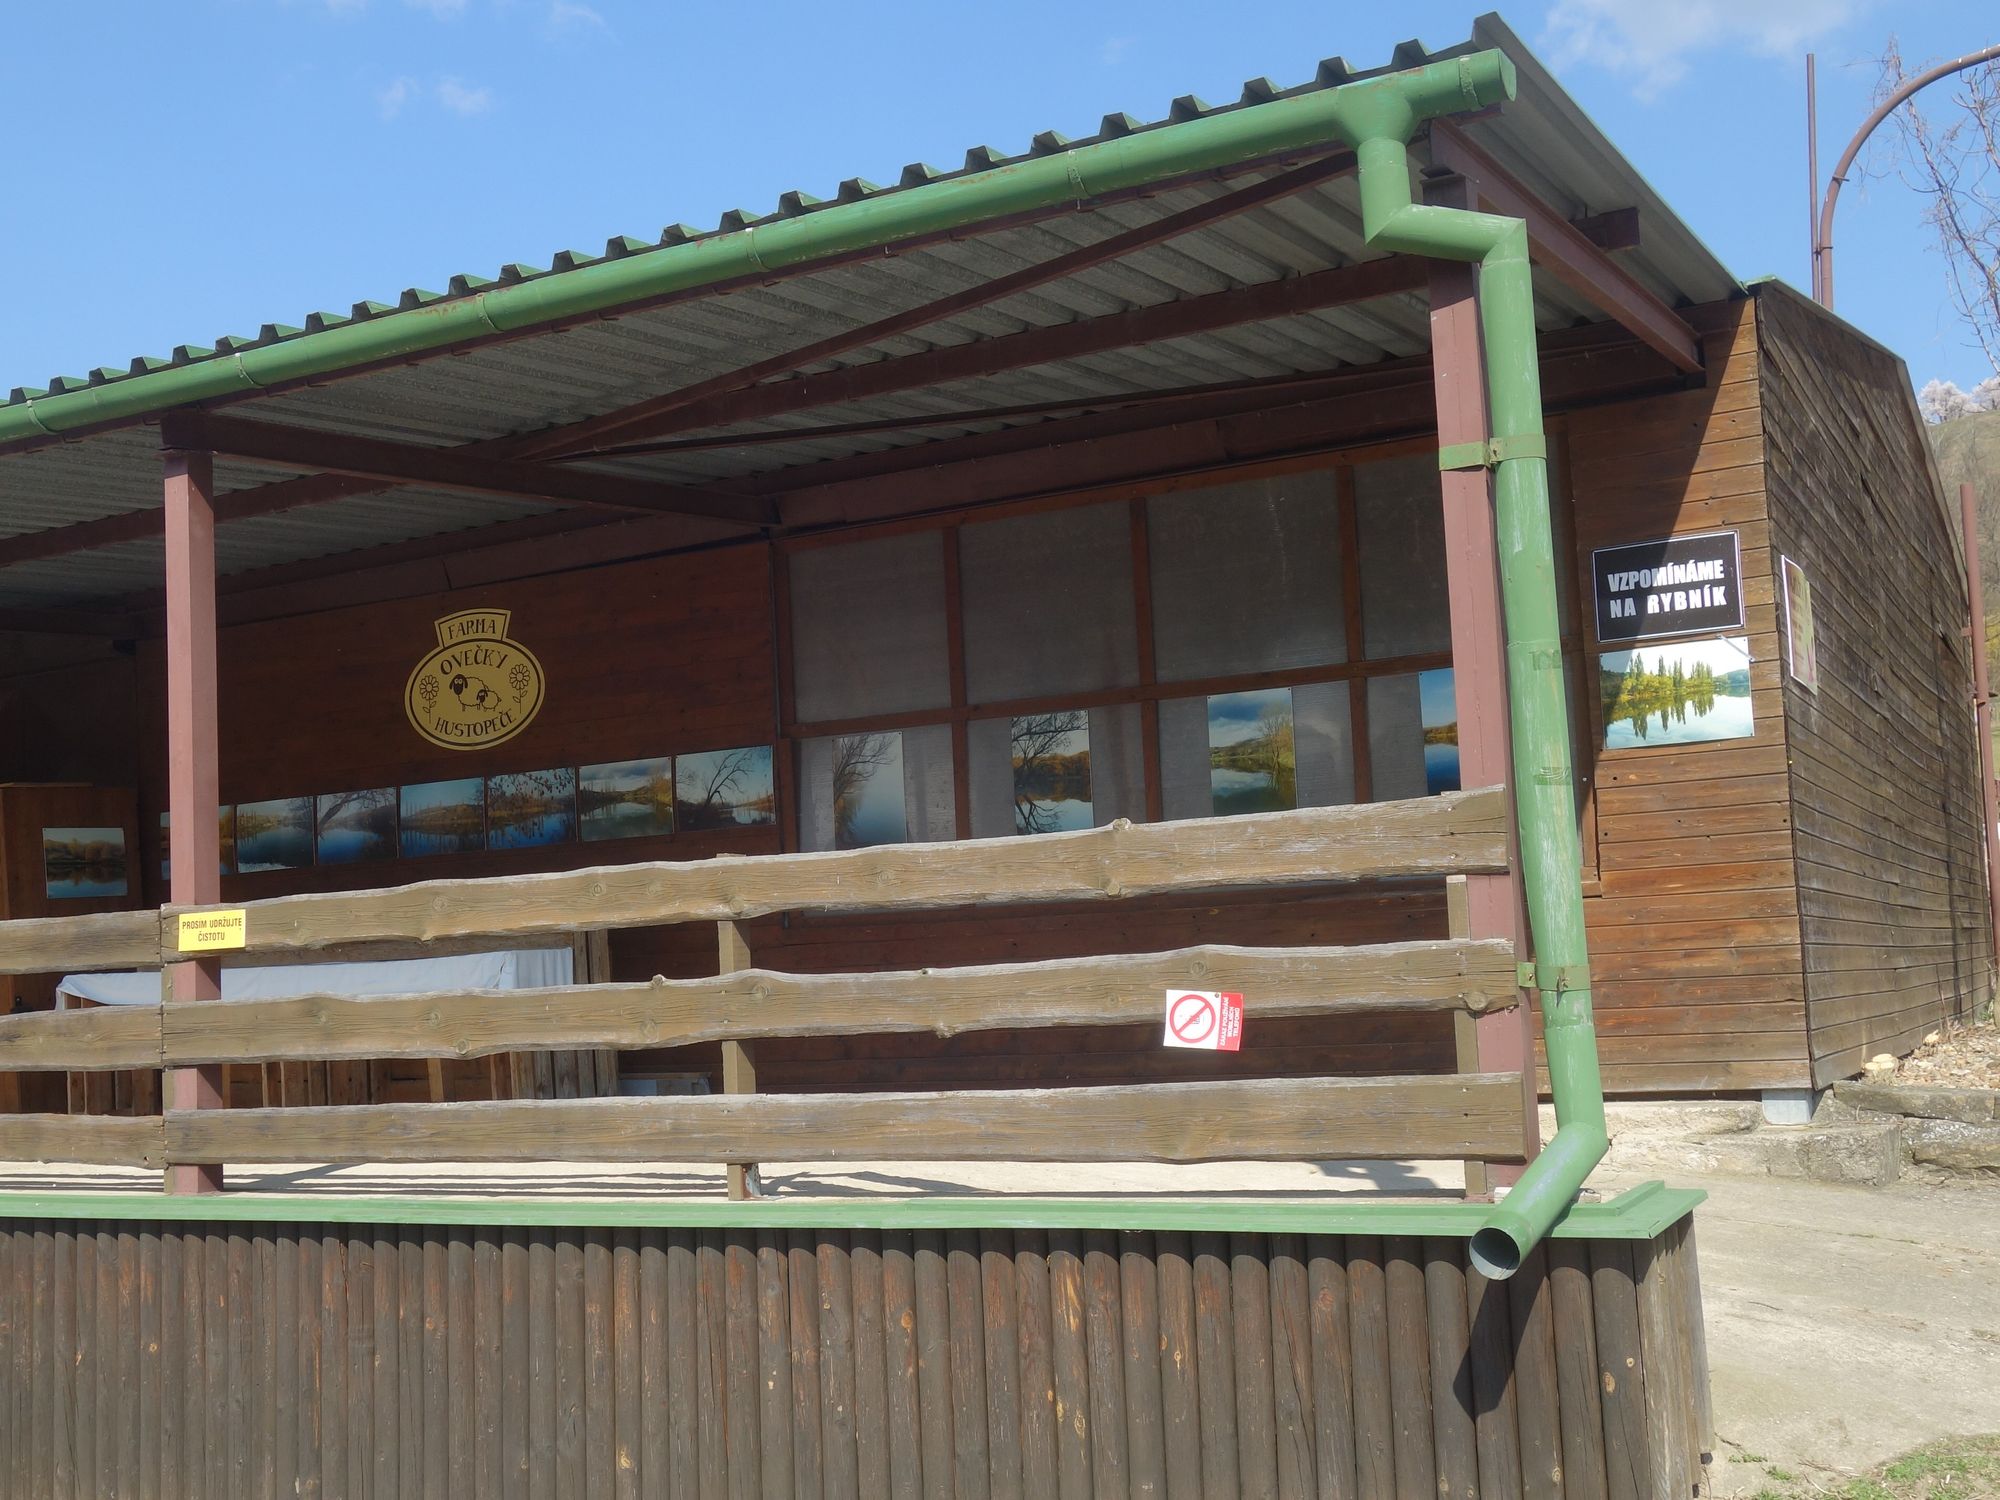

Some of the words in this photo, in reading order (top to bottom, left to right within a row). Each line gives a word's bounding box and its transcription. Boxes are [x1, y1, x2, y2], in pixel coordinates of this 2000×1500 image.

[1607, 559, 1725, 592] VZPOMÍNÁME
[1609, 597, 1636, 619] NA
[1647, 584, 1727, 614] RYBNÍK
[448, 618, 496, 640] FARMA
[440, 645, 508, 675] OVEČKY
[434, 708, 517, 738] HUSTOPEČE
[198, 931, 225, 942] ČISTOTU
[209, 916, 242, 928] UDRŽUJTE
